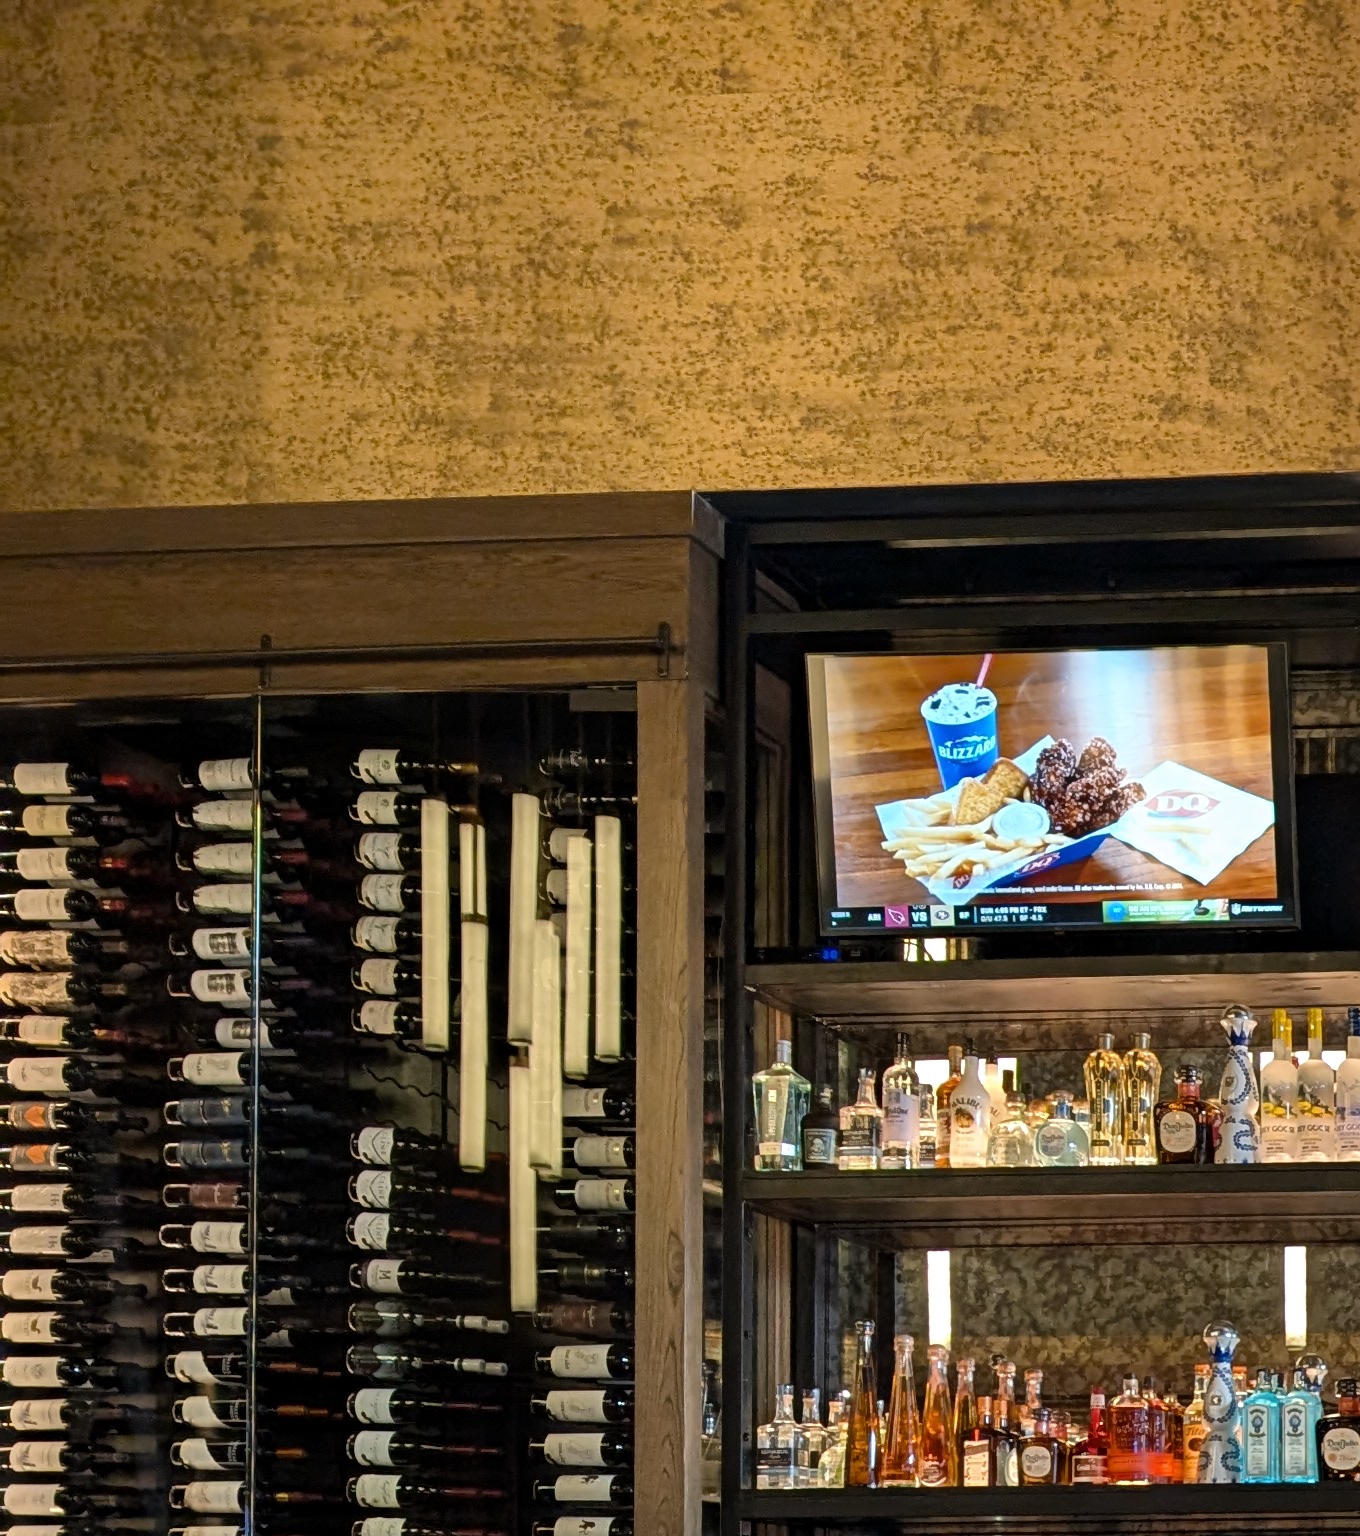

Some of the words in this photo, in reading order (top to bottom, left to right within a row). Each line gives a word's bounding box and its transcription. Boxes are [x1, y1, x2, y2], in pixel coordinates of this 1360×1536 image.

[939, 737, 995, 758] BLIZZARD
[1154, 795, 1210, 812] DQ
[912, 912, 927, 922] VS
